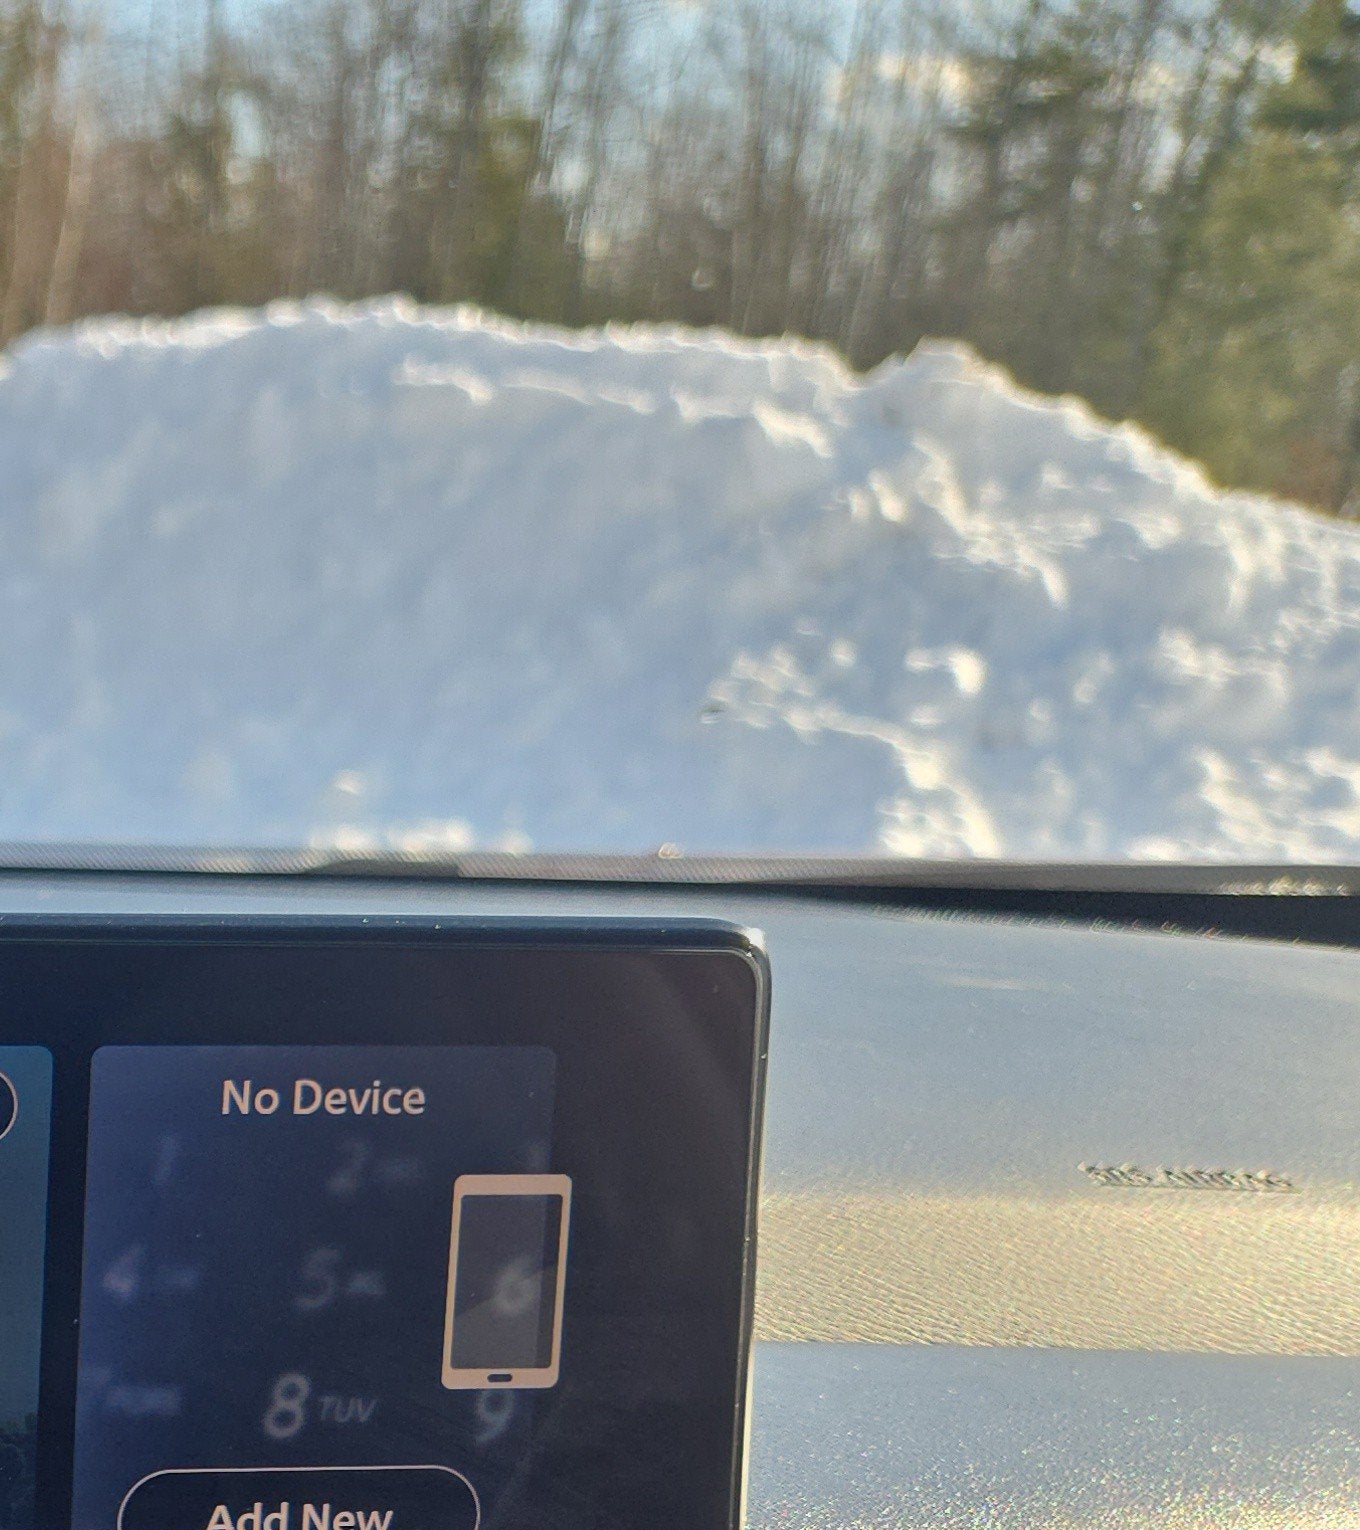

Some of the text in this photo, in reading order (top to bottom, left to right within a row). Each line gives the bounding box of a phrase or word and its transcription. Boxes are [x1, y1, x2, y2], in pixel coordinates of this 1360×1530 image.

[220, 1079, 427, 1116] No Device
[262, 1372, 312, 1440] 8
